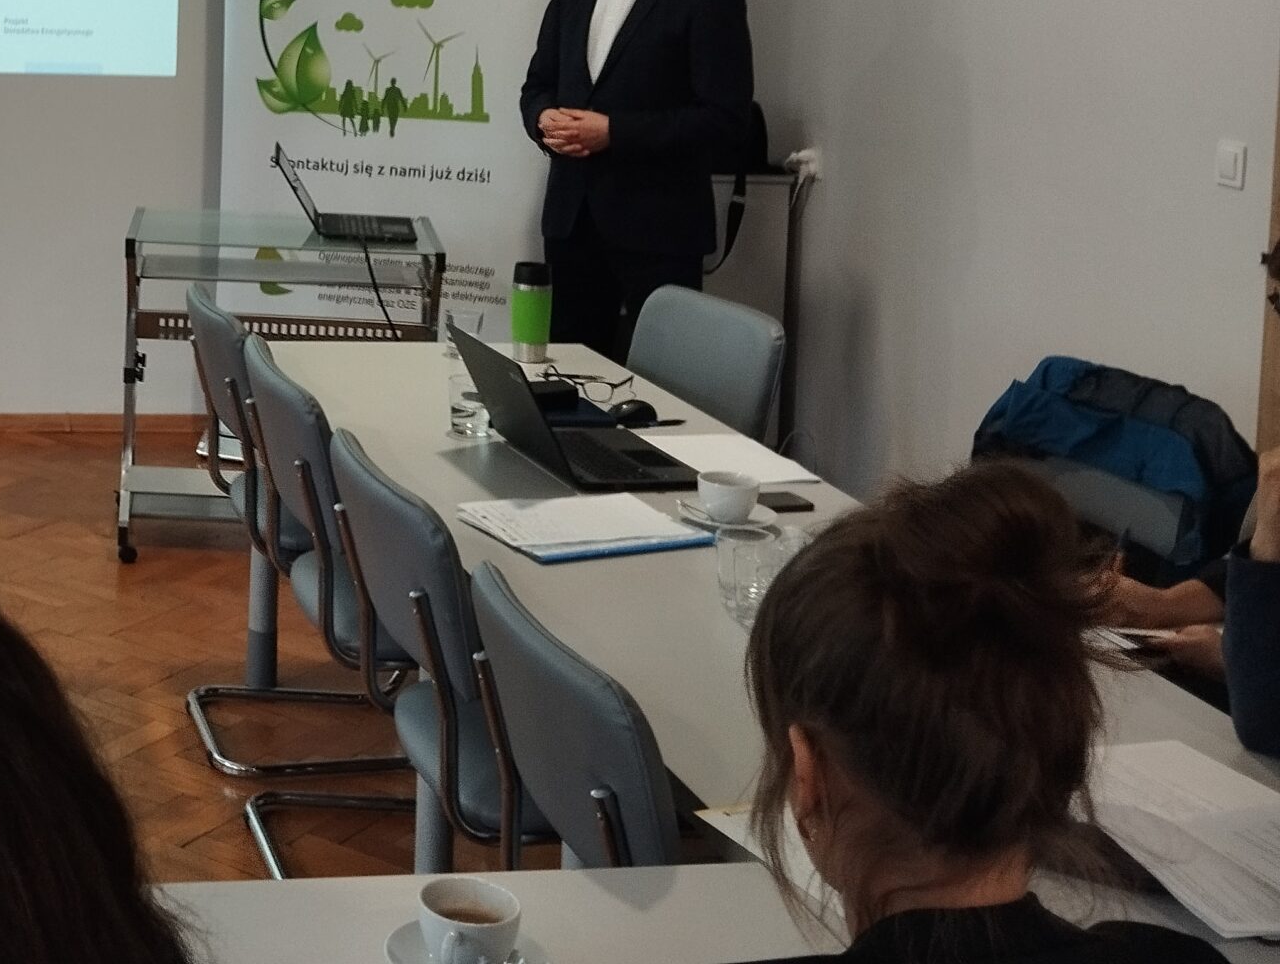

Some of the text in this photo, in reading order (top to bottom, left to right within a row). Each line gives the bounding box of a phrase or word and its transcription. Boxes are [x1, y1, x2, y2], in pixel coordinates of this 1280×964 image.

[269, 155, 491, 184] Sontaktuj się z nami już dziś!
